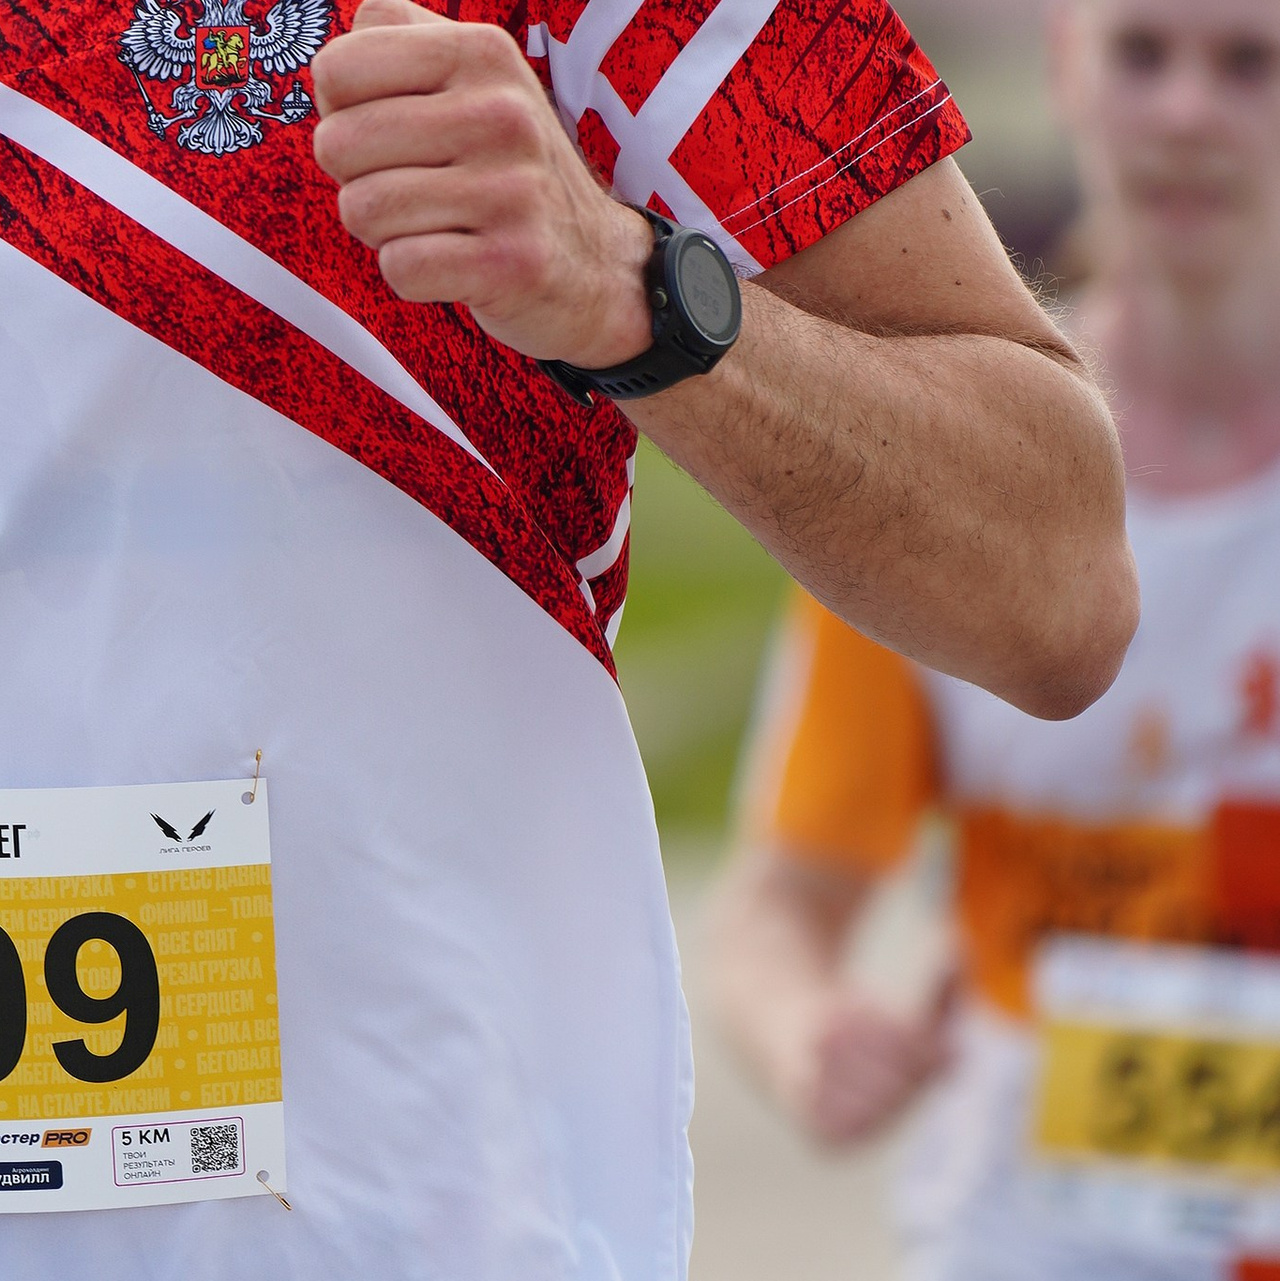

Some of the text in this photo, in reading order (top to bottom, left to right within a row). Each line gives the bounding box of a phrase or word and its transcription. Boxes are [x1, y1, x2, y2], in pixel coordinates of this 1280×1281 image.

[147, 870, 211, 893] СТРЕСС
[140, 899, 209, 926] ФИНИШ
[158, 931, 191, 956] ВСЕ
[193, 927, 237, 953] СПЯТ
[159, 957, 263, 986] РЕЗАГРУЗКА
[176, 989, 255, 1017] СЕРДЦЕМ
[206, 1019, 252, 1046] ПОКА
[197, 1046, 271, 1075] БЕГОВАЯ
[18, 1093, 39, 1118] НА
[42, 1090, 105, 1117] СТАРТЕ
[201, 1081, 240, 1106] БЕГУ
[44, 1130, 88, 1146] PRO
[122, 1131, 132, 1146] 5
[123, 1151, 146, 1160] ТВОИ
[123, 1158, 175, 1170] РЕЗУЛЬТАТЫ
[123, 1169, 161, 1180] ОНЛАЙН
